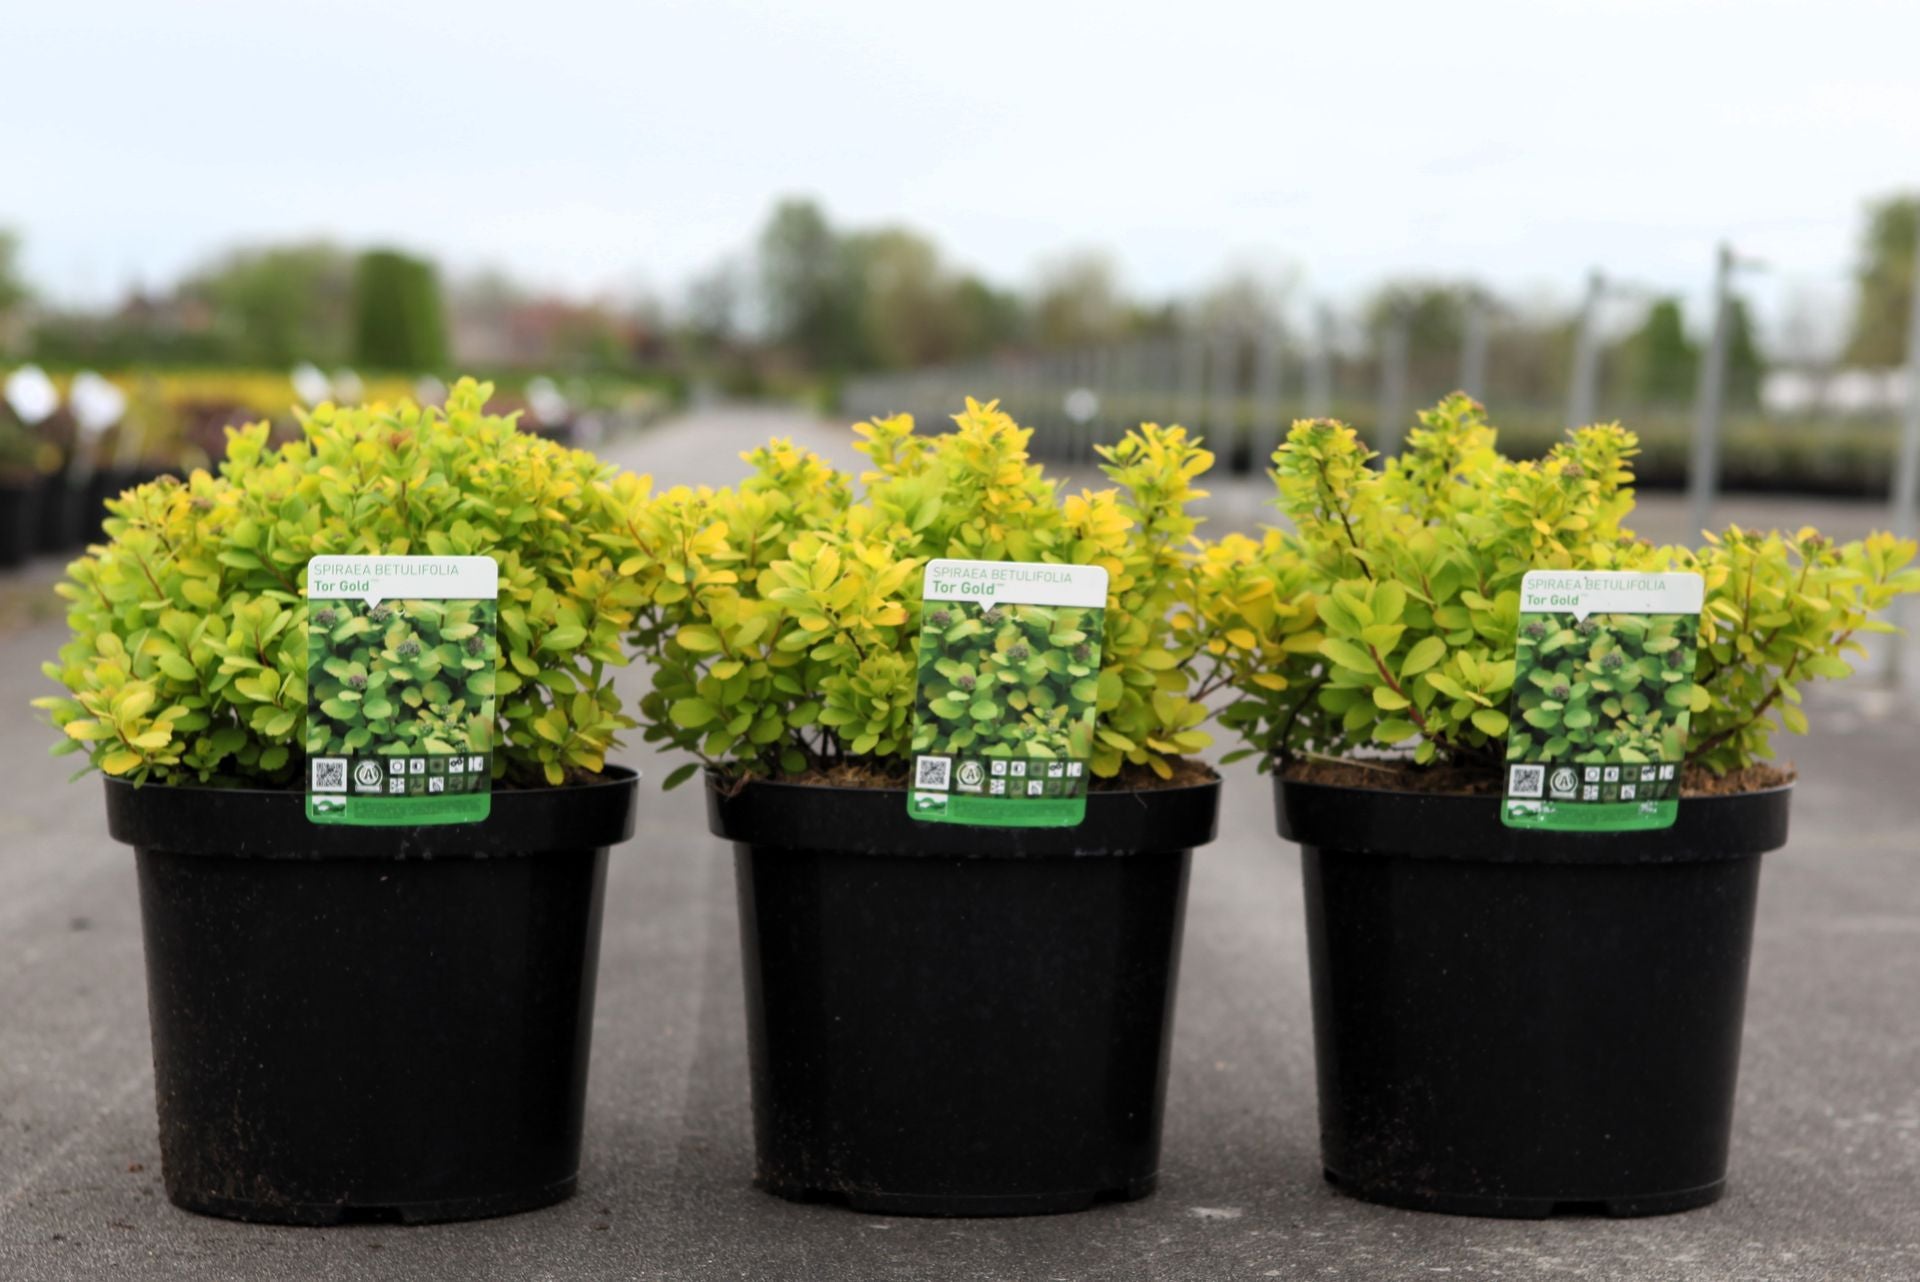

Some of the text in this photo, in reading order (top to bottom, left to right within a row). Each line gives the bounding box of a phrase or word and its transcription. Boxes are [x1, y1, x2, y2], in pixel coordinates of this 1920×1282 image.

[314, 563, 459, 576] SPIRAEA BETULIFOLIA
[933, 566, 1073, 583] SPIRAEA BETULIFOLIA
[314, 580, 335, 592] Tor
[933, 580, 956, 594] Tor
[1527, 578, 1666, 591] SPIRAEA BETULIFOLIA
[1527, 594, 1546, 606] Tor
